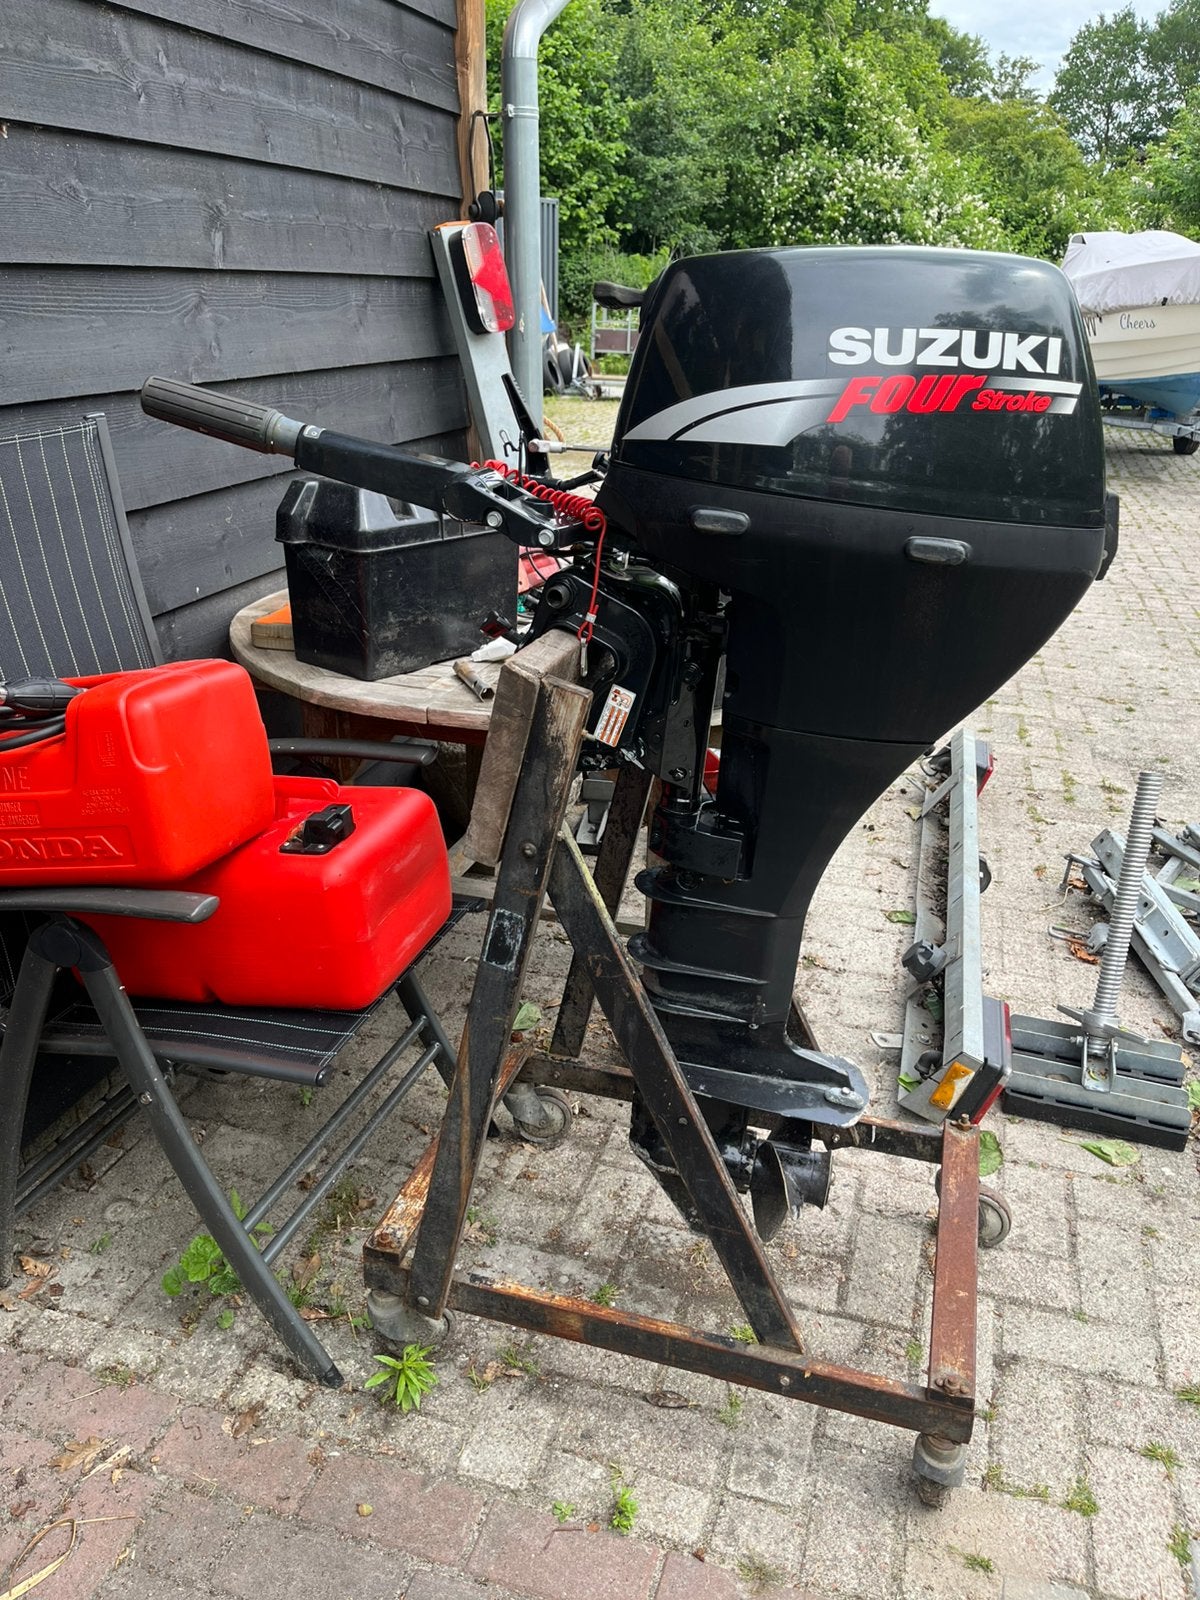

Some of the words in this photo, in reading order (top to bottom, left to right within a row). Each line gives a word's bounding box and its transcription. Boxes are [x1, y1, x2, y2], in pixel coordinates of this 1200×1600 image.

[1119, 313, 1156, 330] Cheers
[828, 327, 1062, 374] SUZUKI
[971, 389, 1053, 413] Stroke
